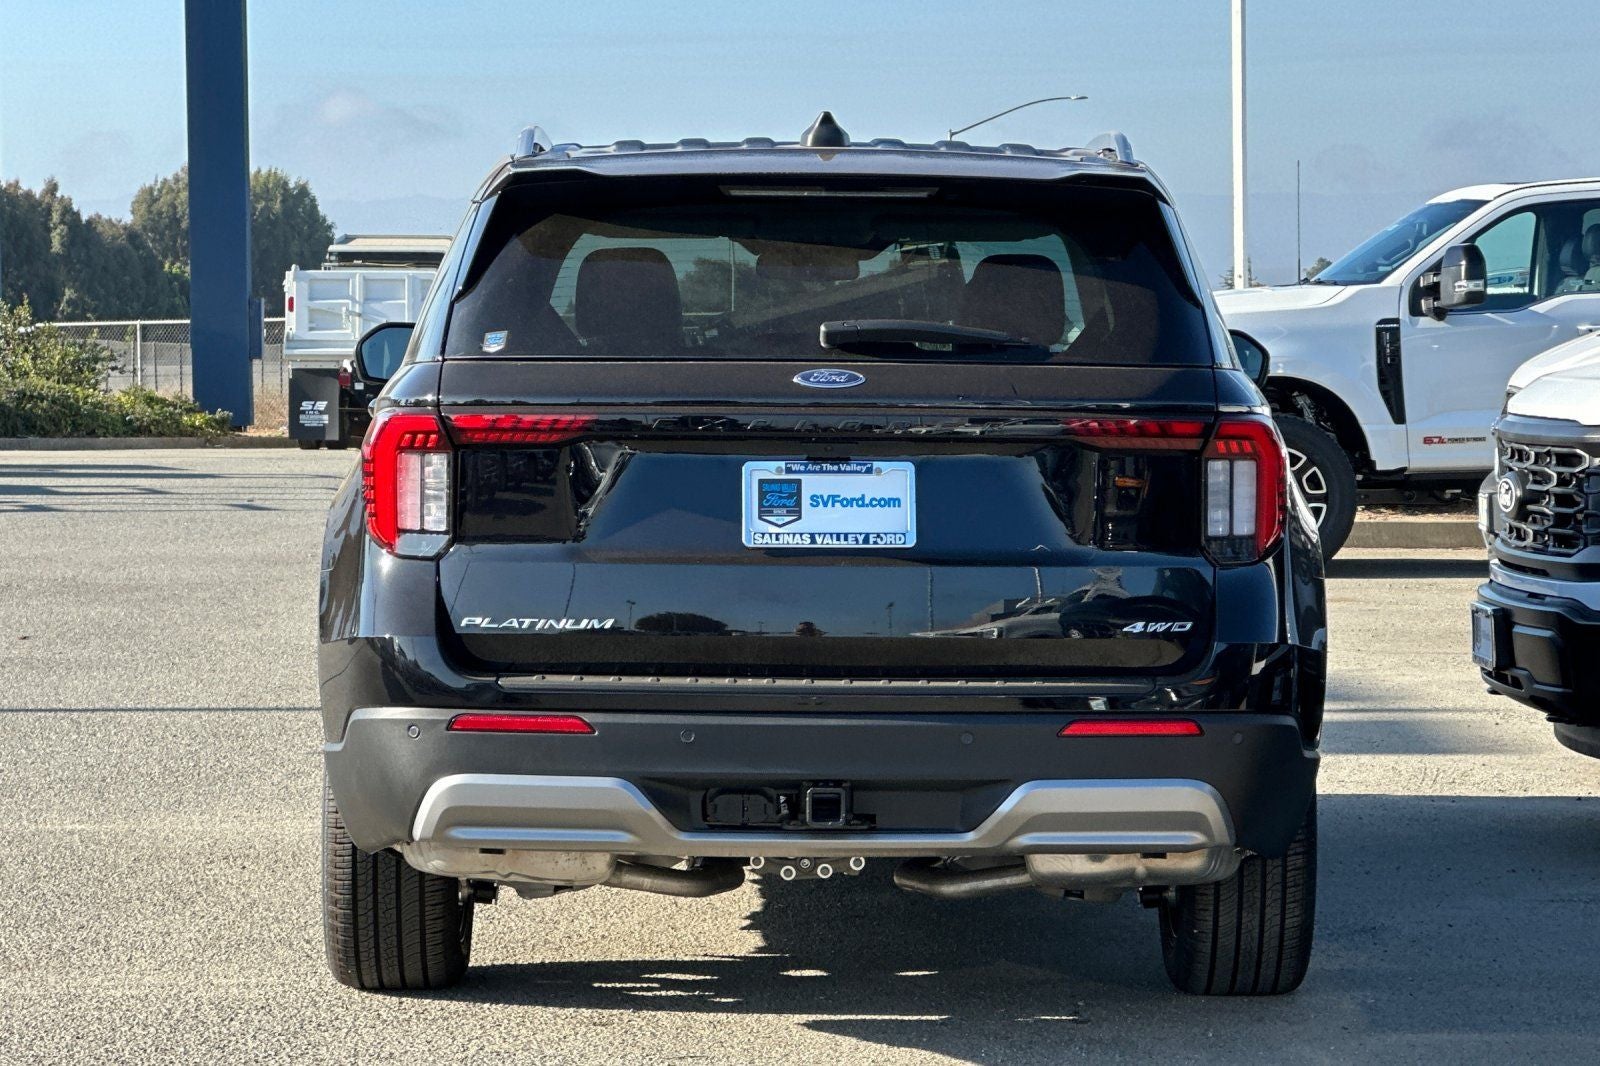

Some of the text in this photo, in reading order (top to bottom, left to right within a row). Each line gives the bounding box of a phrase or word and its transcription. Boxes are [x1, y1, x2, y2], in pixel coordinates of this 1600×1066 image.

[809, 371, 849, 382] Ford
[807, 463, 821, 471] Are
[822, 463, 840, 471] The
[763, 492, 797, 507] Ford
[809, 494, 902, 508] SVFord.com
[754, 533, 905, 545] SALINAS VALLEY FORD
[460, 617, 615, 630] PLATINUM
[1122, 621, 1193, 632] 4WD
